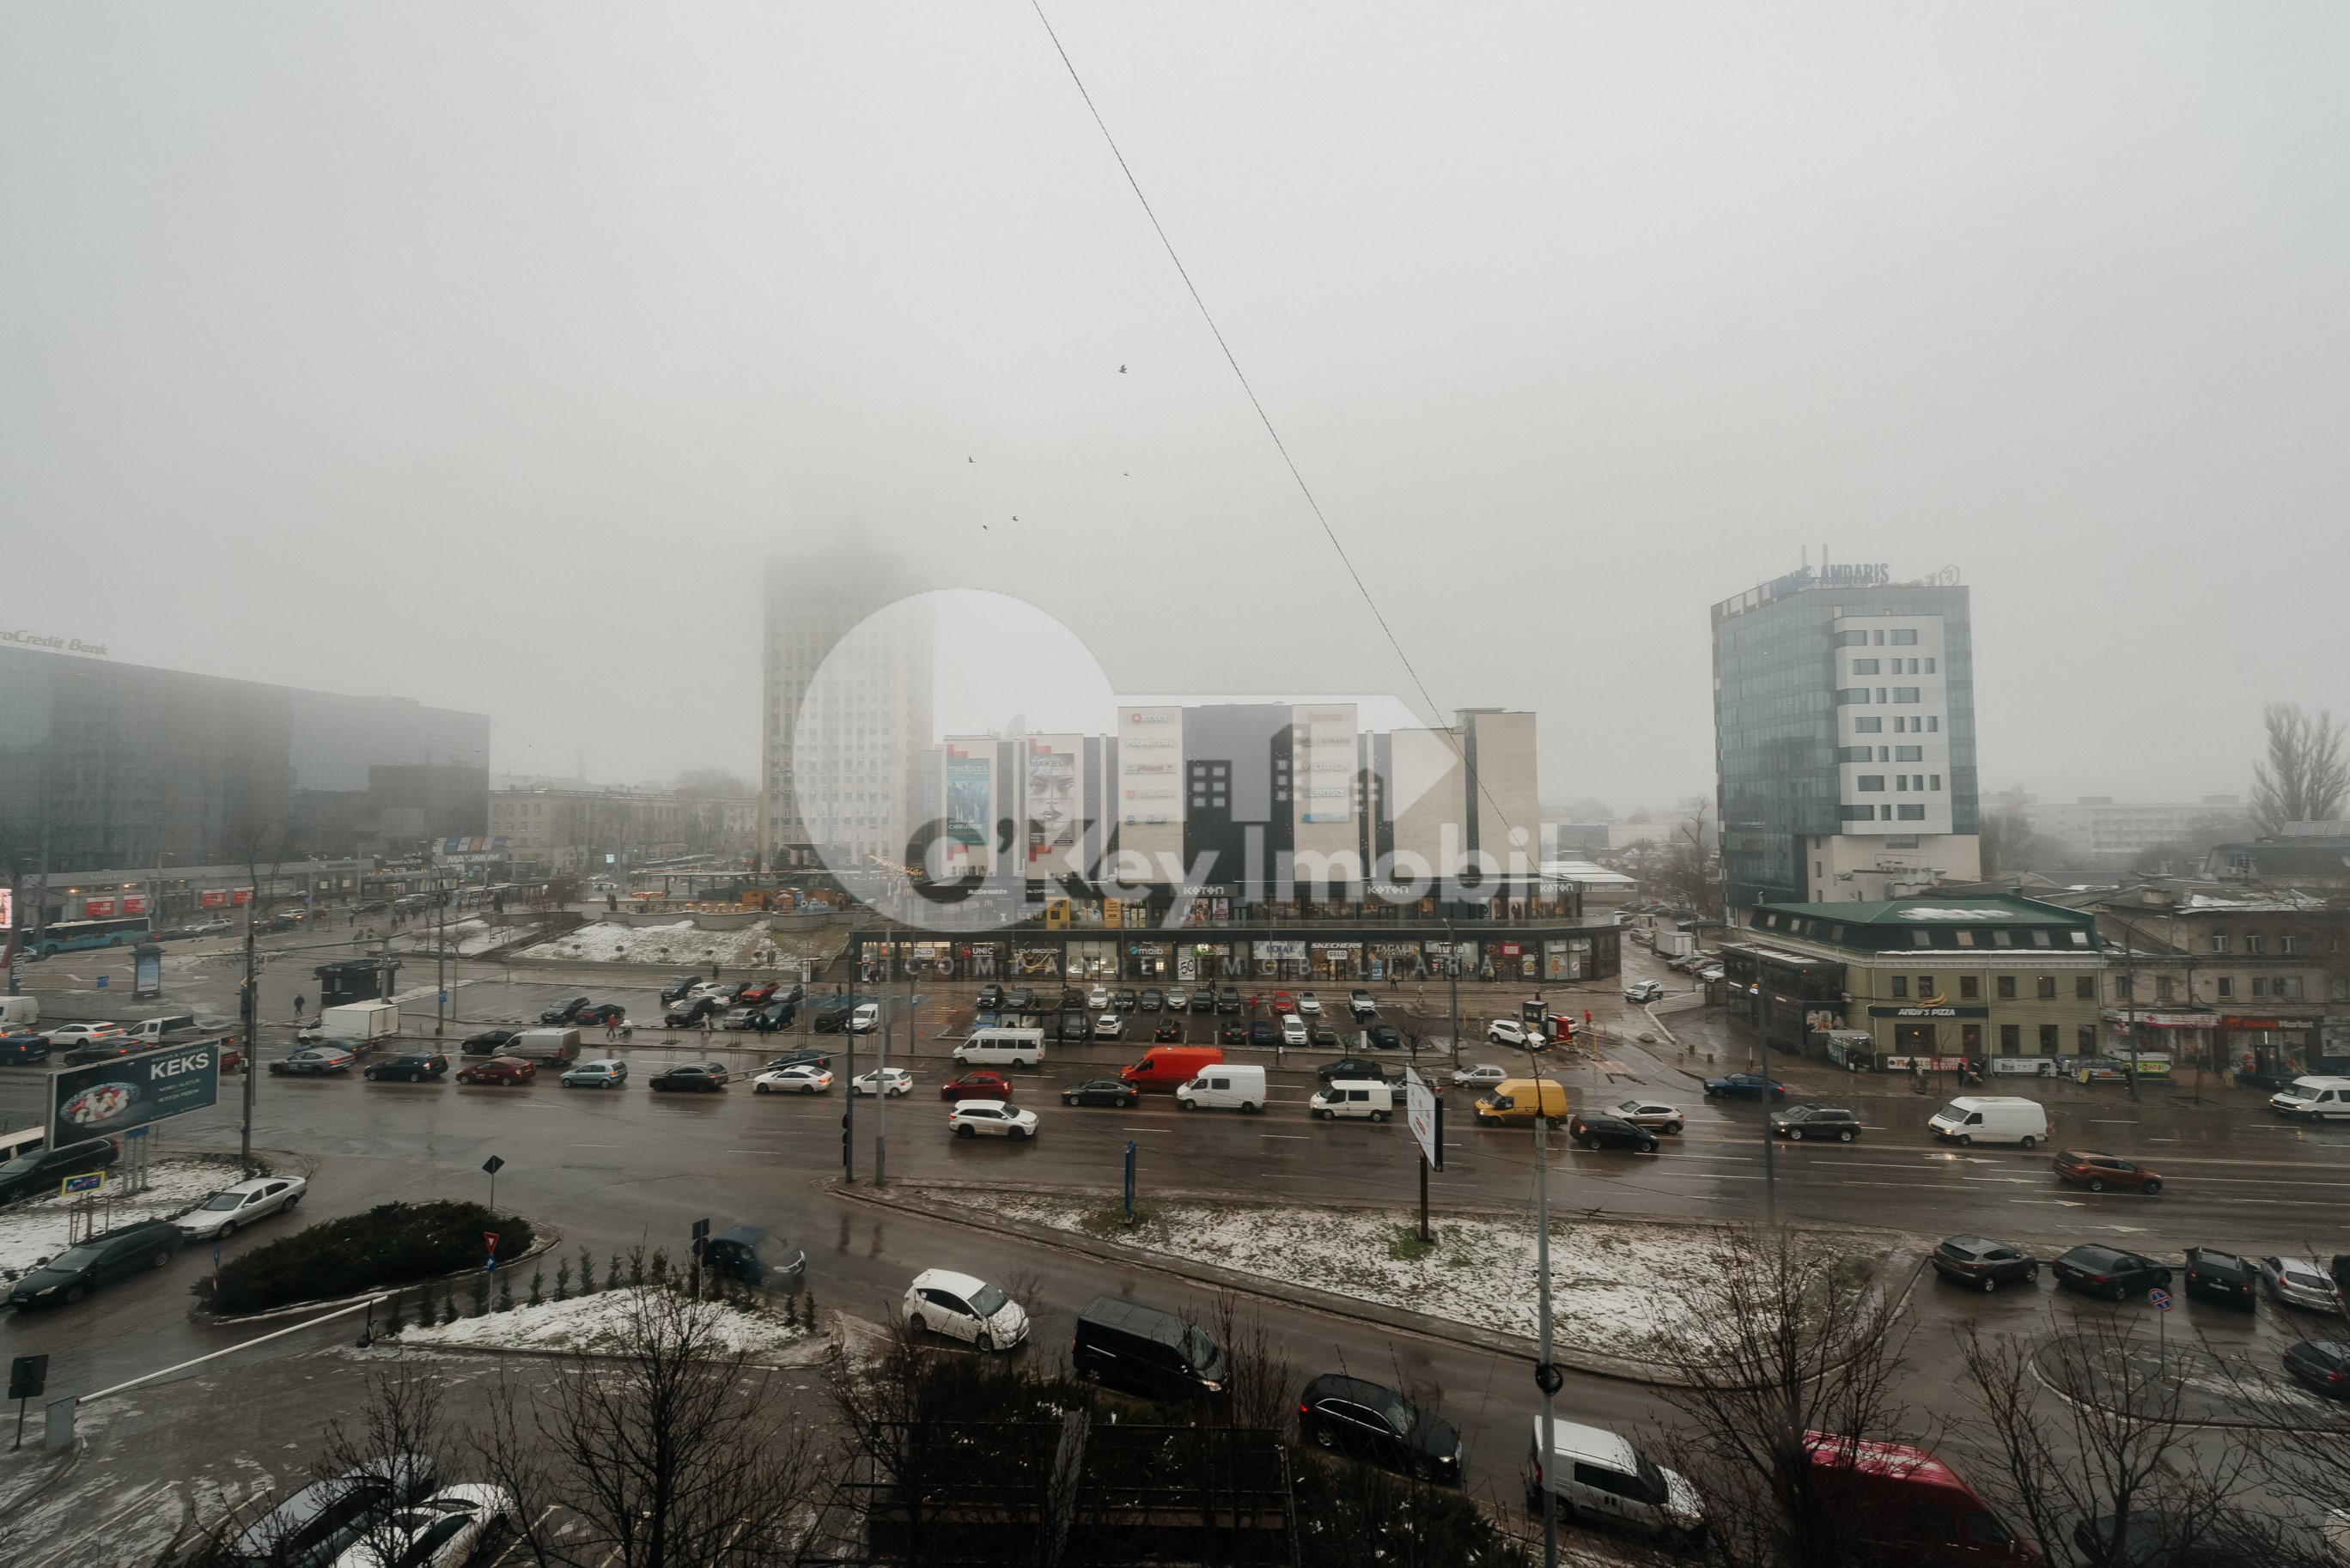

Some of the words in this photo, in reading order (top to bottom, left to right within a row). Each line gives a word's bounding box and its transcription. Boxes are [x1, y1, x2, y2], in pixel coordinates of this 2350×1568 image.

[1820, 563, 1890, 585] AMDARIS
[69, 638, 107, 655] Bank
[947, 763, 988, 773] medpark
[1302, 763, 1351, 771] VIORICA
[1309, 788, 1343, 797] Lensa
[447, 854, 499, 864] MAXIMUM
[1184, 885, 1224, 896] KOTON
[1367, 885, 1409, 895] KOTON
[1539, 883, 1574, 892] KOTON
[1138, 945, 1164, 955] maib
[2278, 1020, 2314, 1029] Market
[150, 1052, 210, 1080] KEKS
